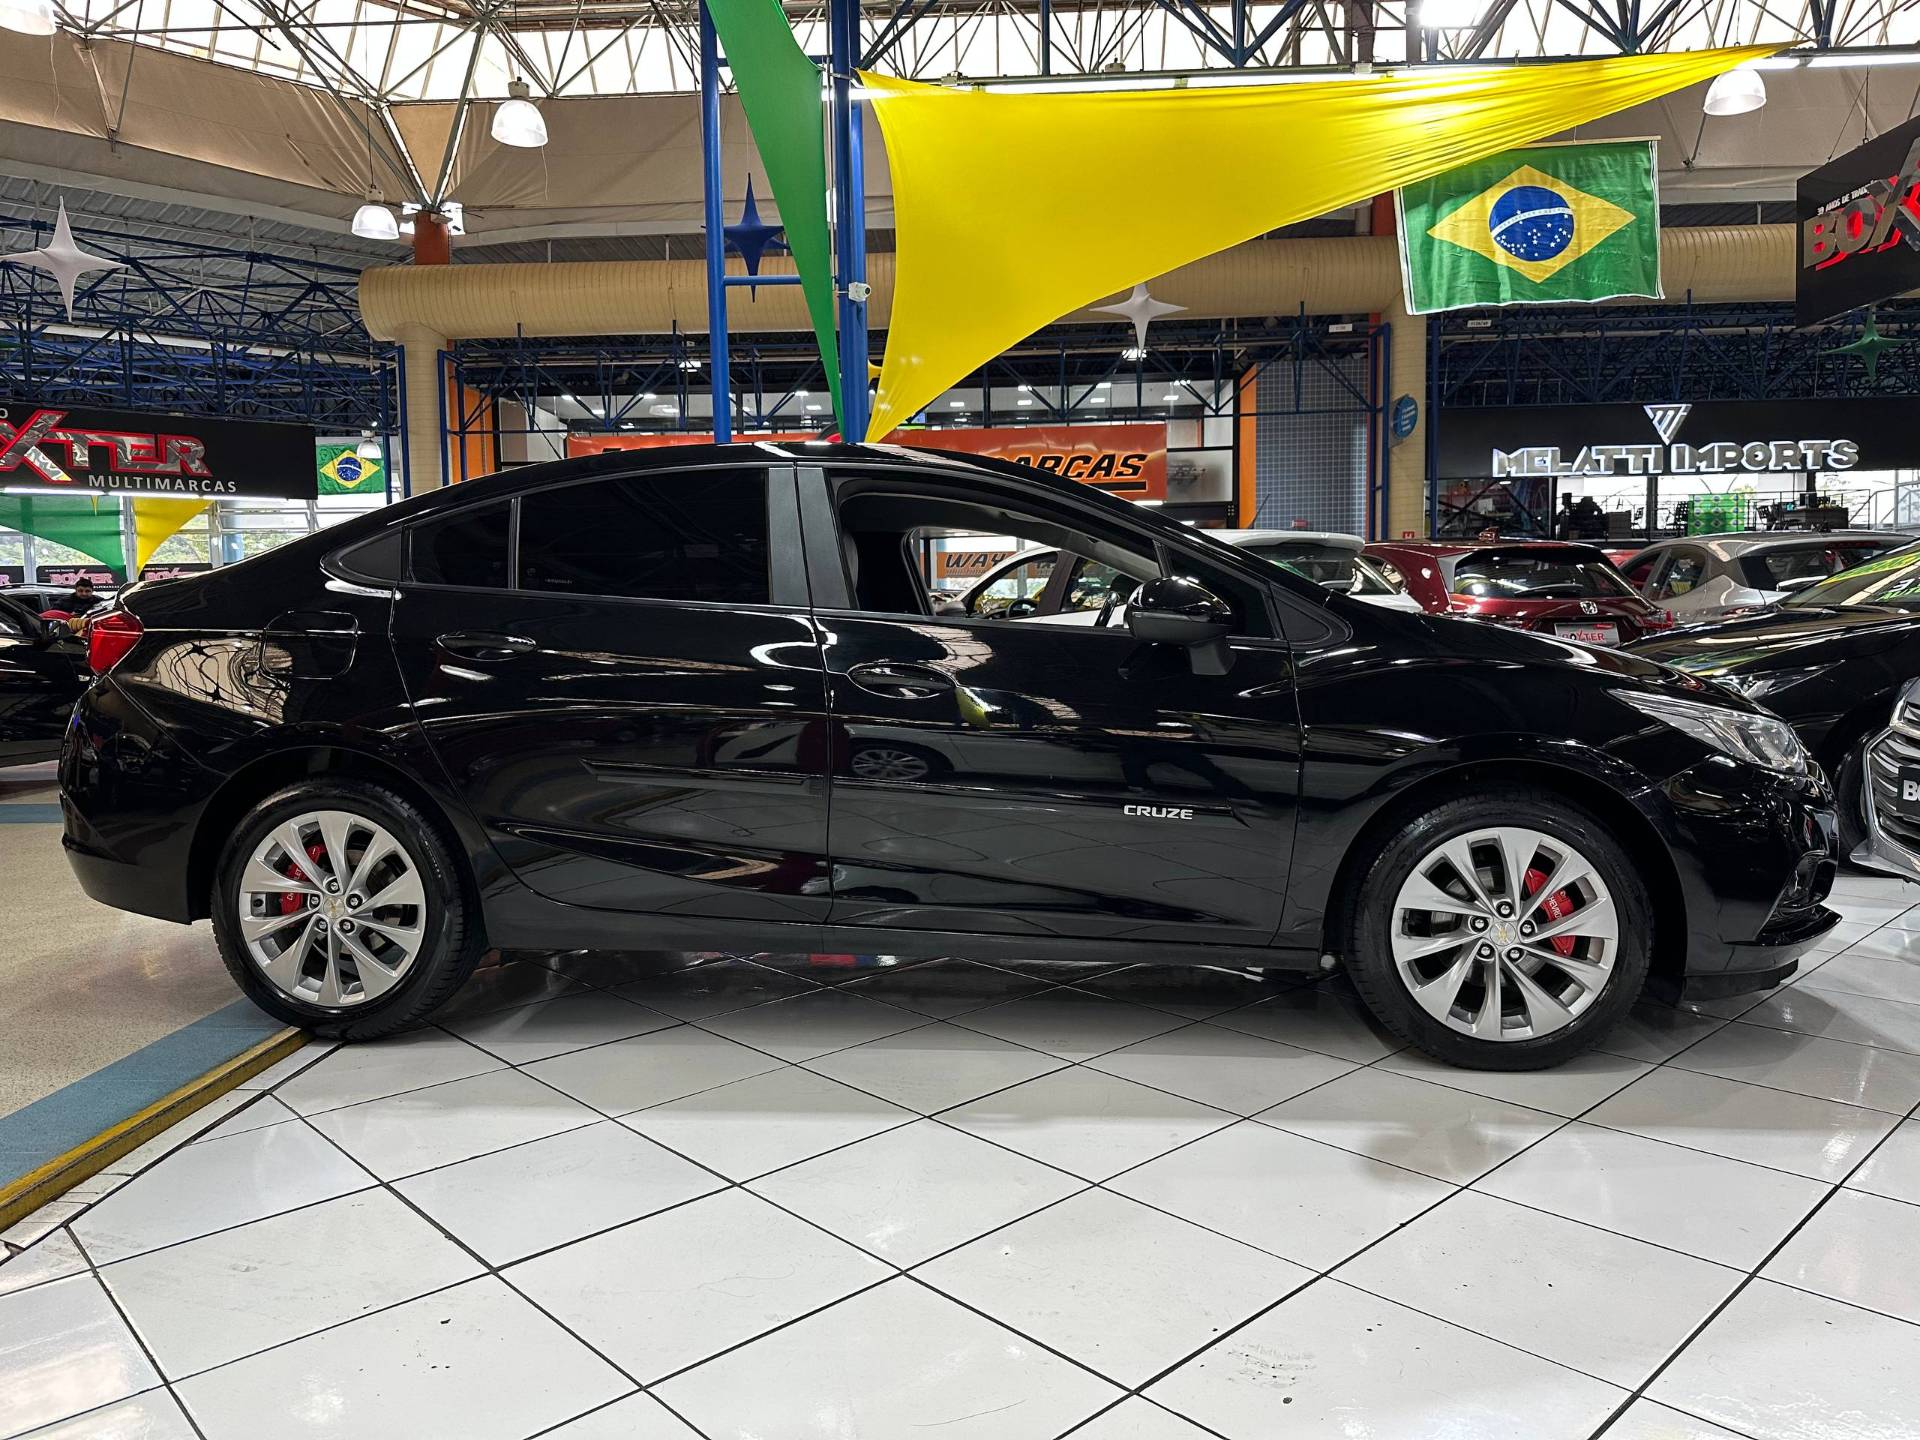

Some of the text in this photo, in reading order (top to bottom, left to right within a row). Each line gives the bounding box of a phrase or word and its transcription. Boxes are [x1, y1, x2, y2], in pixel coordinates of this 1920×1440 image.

[1492, 439, 1860, 478] MELATTI IMPORTS
[88, 474, 238, 493] MULTIMARCAS
[1123, 804, 1193, 820] CRUZE
